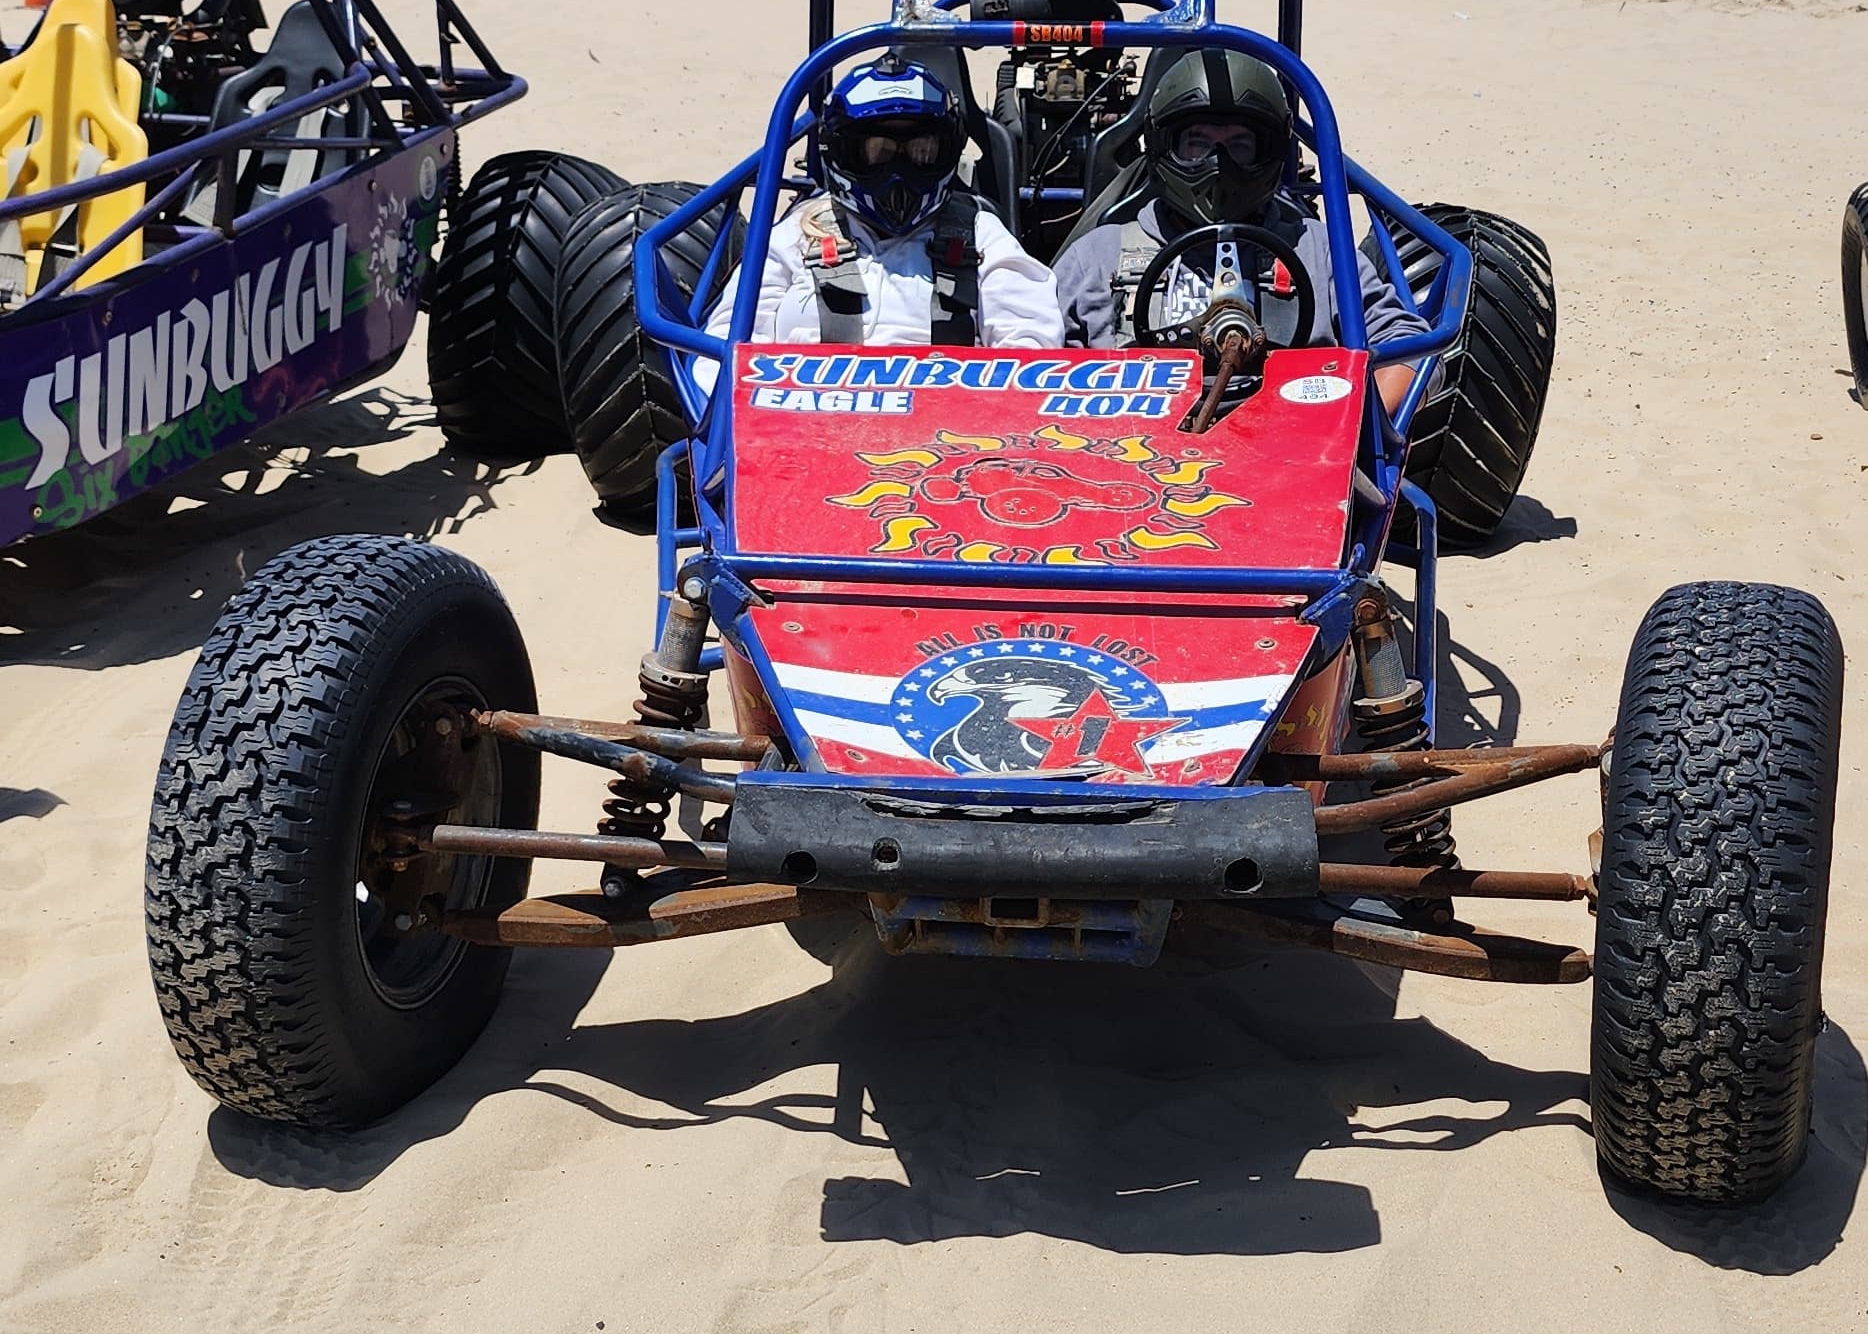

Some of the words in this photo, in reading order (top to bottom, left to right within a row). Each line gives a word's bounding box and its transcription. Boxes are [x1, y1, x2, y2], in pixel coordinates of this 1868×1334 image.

[1030, 25, 1083, 42] SB404
[22, 223, 348, 491] SUNBUGGY
[741, 353, 1194, 391] SUNBUGGIE
[750, 387, 914, 415] EAGLE
[1038, 393, 1171, 418] 404
[915, 631, 964, 659] ALL
[972, 623, 1003, 641] IS
[1020, 623, 1076, 643] NOT
[1088, 633, 1161, 668] LOST
